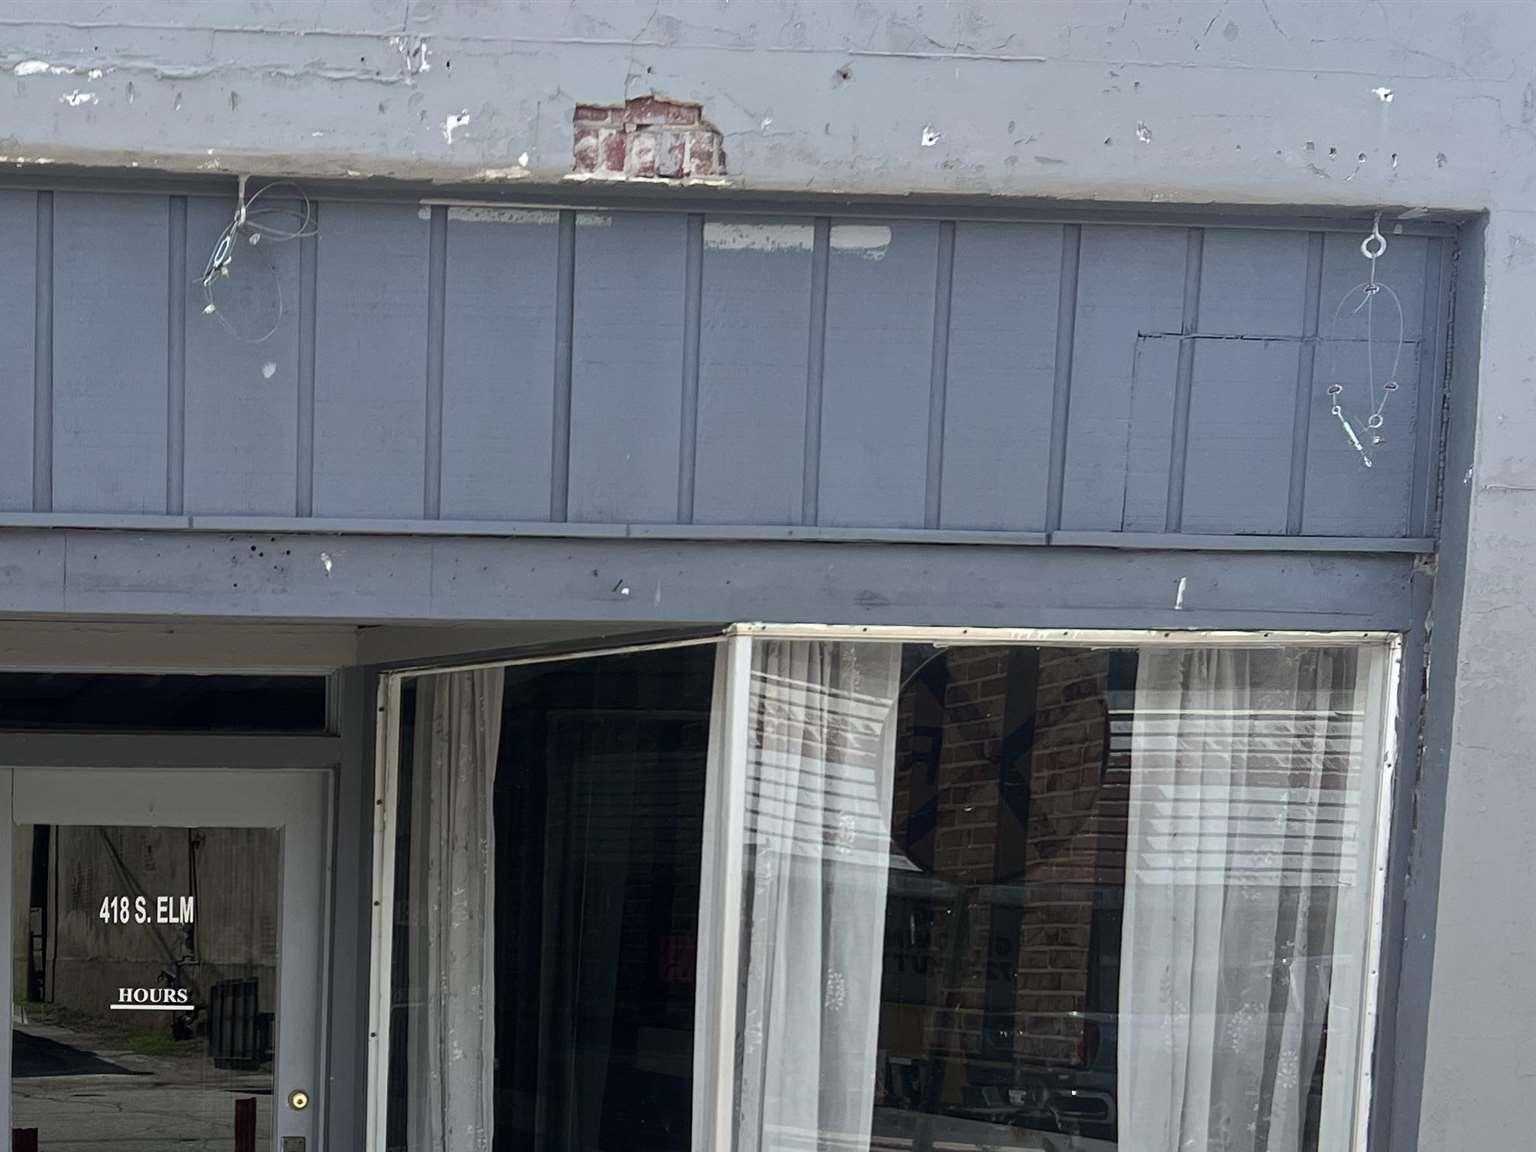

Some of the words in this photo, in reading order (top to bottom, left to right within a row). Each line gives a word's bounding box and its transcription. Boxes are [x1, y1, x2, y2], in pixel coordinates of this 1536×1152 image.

[99, 896, 130, 924] 418
[134, 896, 152, 924] S.
[156, 896, 194, 924] ELM
[118, 988, 189, 1003] HOURS
